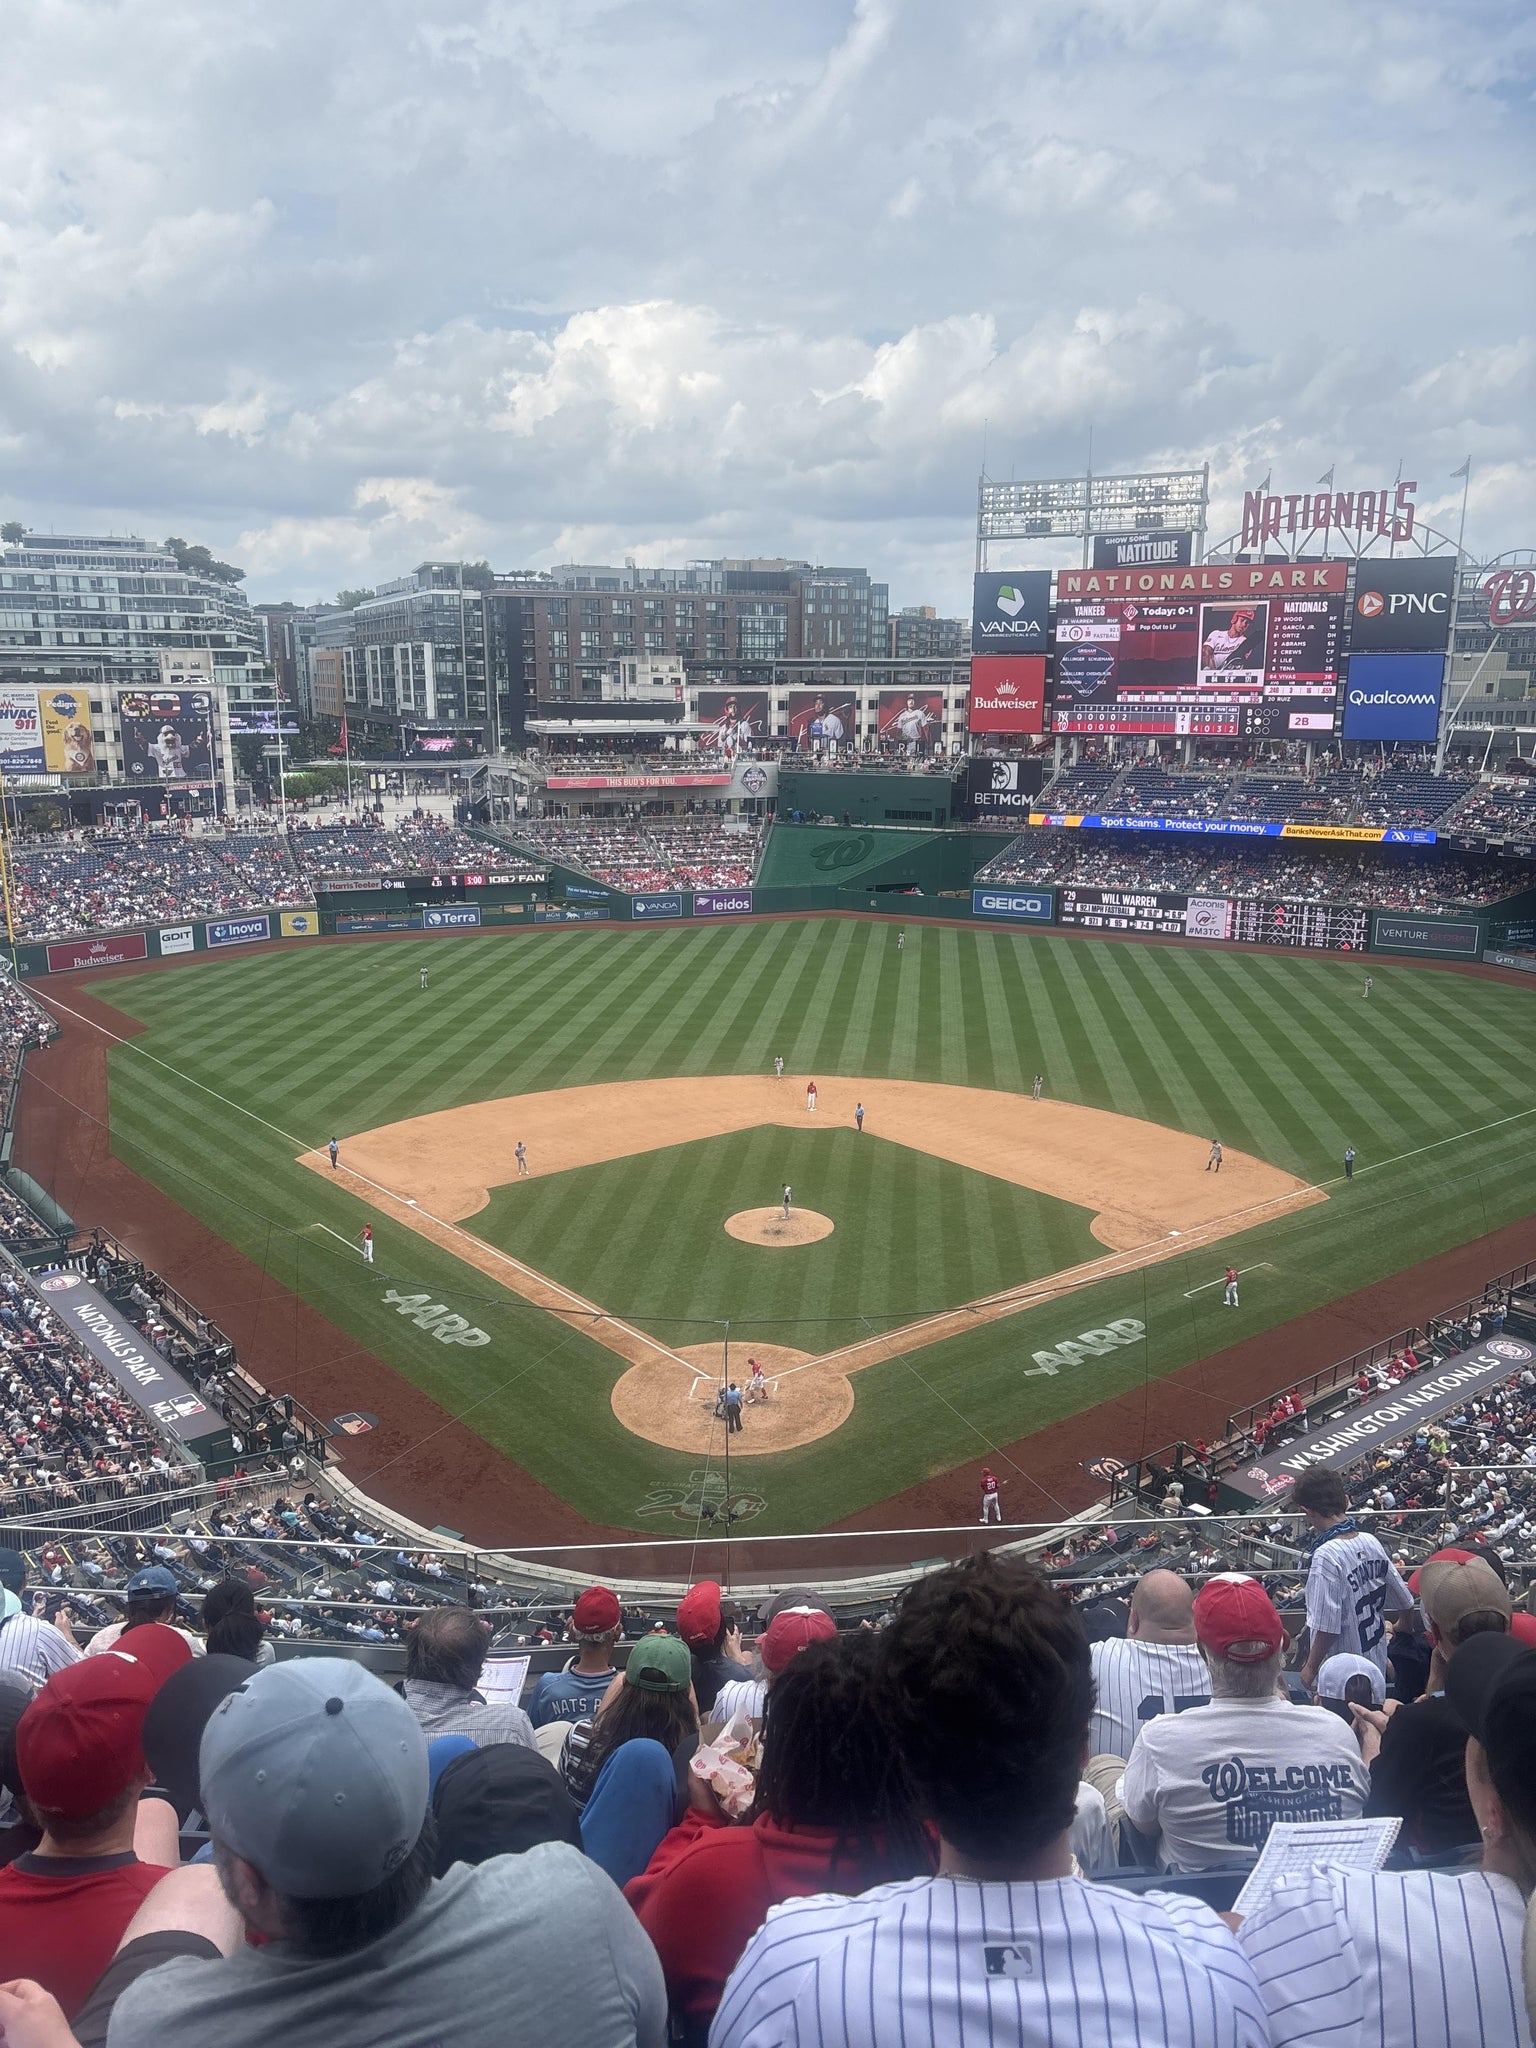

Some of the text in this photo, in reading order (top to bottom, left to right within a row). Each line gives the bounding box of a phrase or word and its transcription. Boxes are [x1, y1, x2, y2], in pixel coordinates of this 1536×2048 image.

[1241, 481, 1417, 547] NATIONALS
[1105, 535, 1150, 545] SHOW SOME
[1117, 540, 1178, 563] NATITUDE
[1067, 569, 1330, 592] NATIONALS PARK
[1284, 601, 1328, 613] NATIONALS
[1388, 592, 1447, 614] PNC
[1075, 606, 1105, 616] YANKEES
[1142, 607, 1193, 616] Today: 0-1
[980, 620, 1041, 633] VANDA
[974, 697, 1038, 709] Budweiser
[1349, 689, 1436, 706] Qualcomm
[0, 709, 37, 719] HVAC
[15, 719, 36, 730] 911
[1294, 717, 1309, 726] 2B
[1193, 725, 1198, 733] 4
[1204, 725, 1210, 733] 0
[1229, 725, 1234, 733] 2
[606, 777, 678, 787] THIS BUD'S FOR YOU.
[974, 793, 1034, 806] BETMGM
[1101, 816, 1267, 835] Spot Scams. Protect your money.
[1286, 826, 1382, 839] BanksNeverAskThat.com
[329, 881, 380, 890] Harris Teeter
[393, 881, 406, 889] HILL
[467, 875, 482, 885] 3:00
[519, 874, 545, 883] FAN
[712, 898, 750, 911] leidos
[982, 896, 1042, 912] GEICO
[1063, 891, 1157, 907] #29 WILL WARREN
[1190, 899, 1225, 910] Acronis
[645, 902, 678, 910] VANDA
[1091, 905, 1104, 913] MPH
[1104, 906, 1130, 915] FASTBALL
[442, 912, 476, 923] Terra
[229, 923, 262, 936] Inova
[1188, 927, 1221, 937] #M3TC
[1382, 928, 1429, 940] VENTURE
[161, 931, 192, 942] GDIT
[73, 952, 125, 968] Budweiser
[381, 1289, 492, 1347] AARP
[73, 1303, 164, 1386] NATIONALS PARK
[1023, 1318, 1147, 1376] AARP
[148, 1401, 180, 1424] MLB
[1279, 1355, 1502, 1471] WASHINGTON NATIONALS
[986, 1482, 996, 1490] 20
[1347, 1559, 1389, 1592] STANTON
[562, 1631, 569, 1641] 2
[551, 1698, 588, 1715] NATS
[1202, 1757, 1354, 1802] WELCOME
